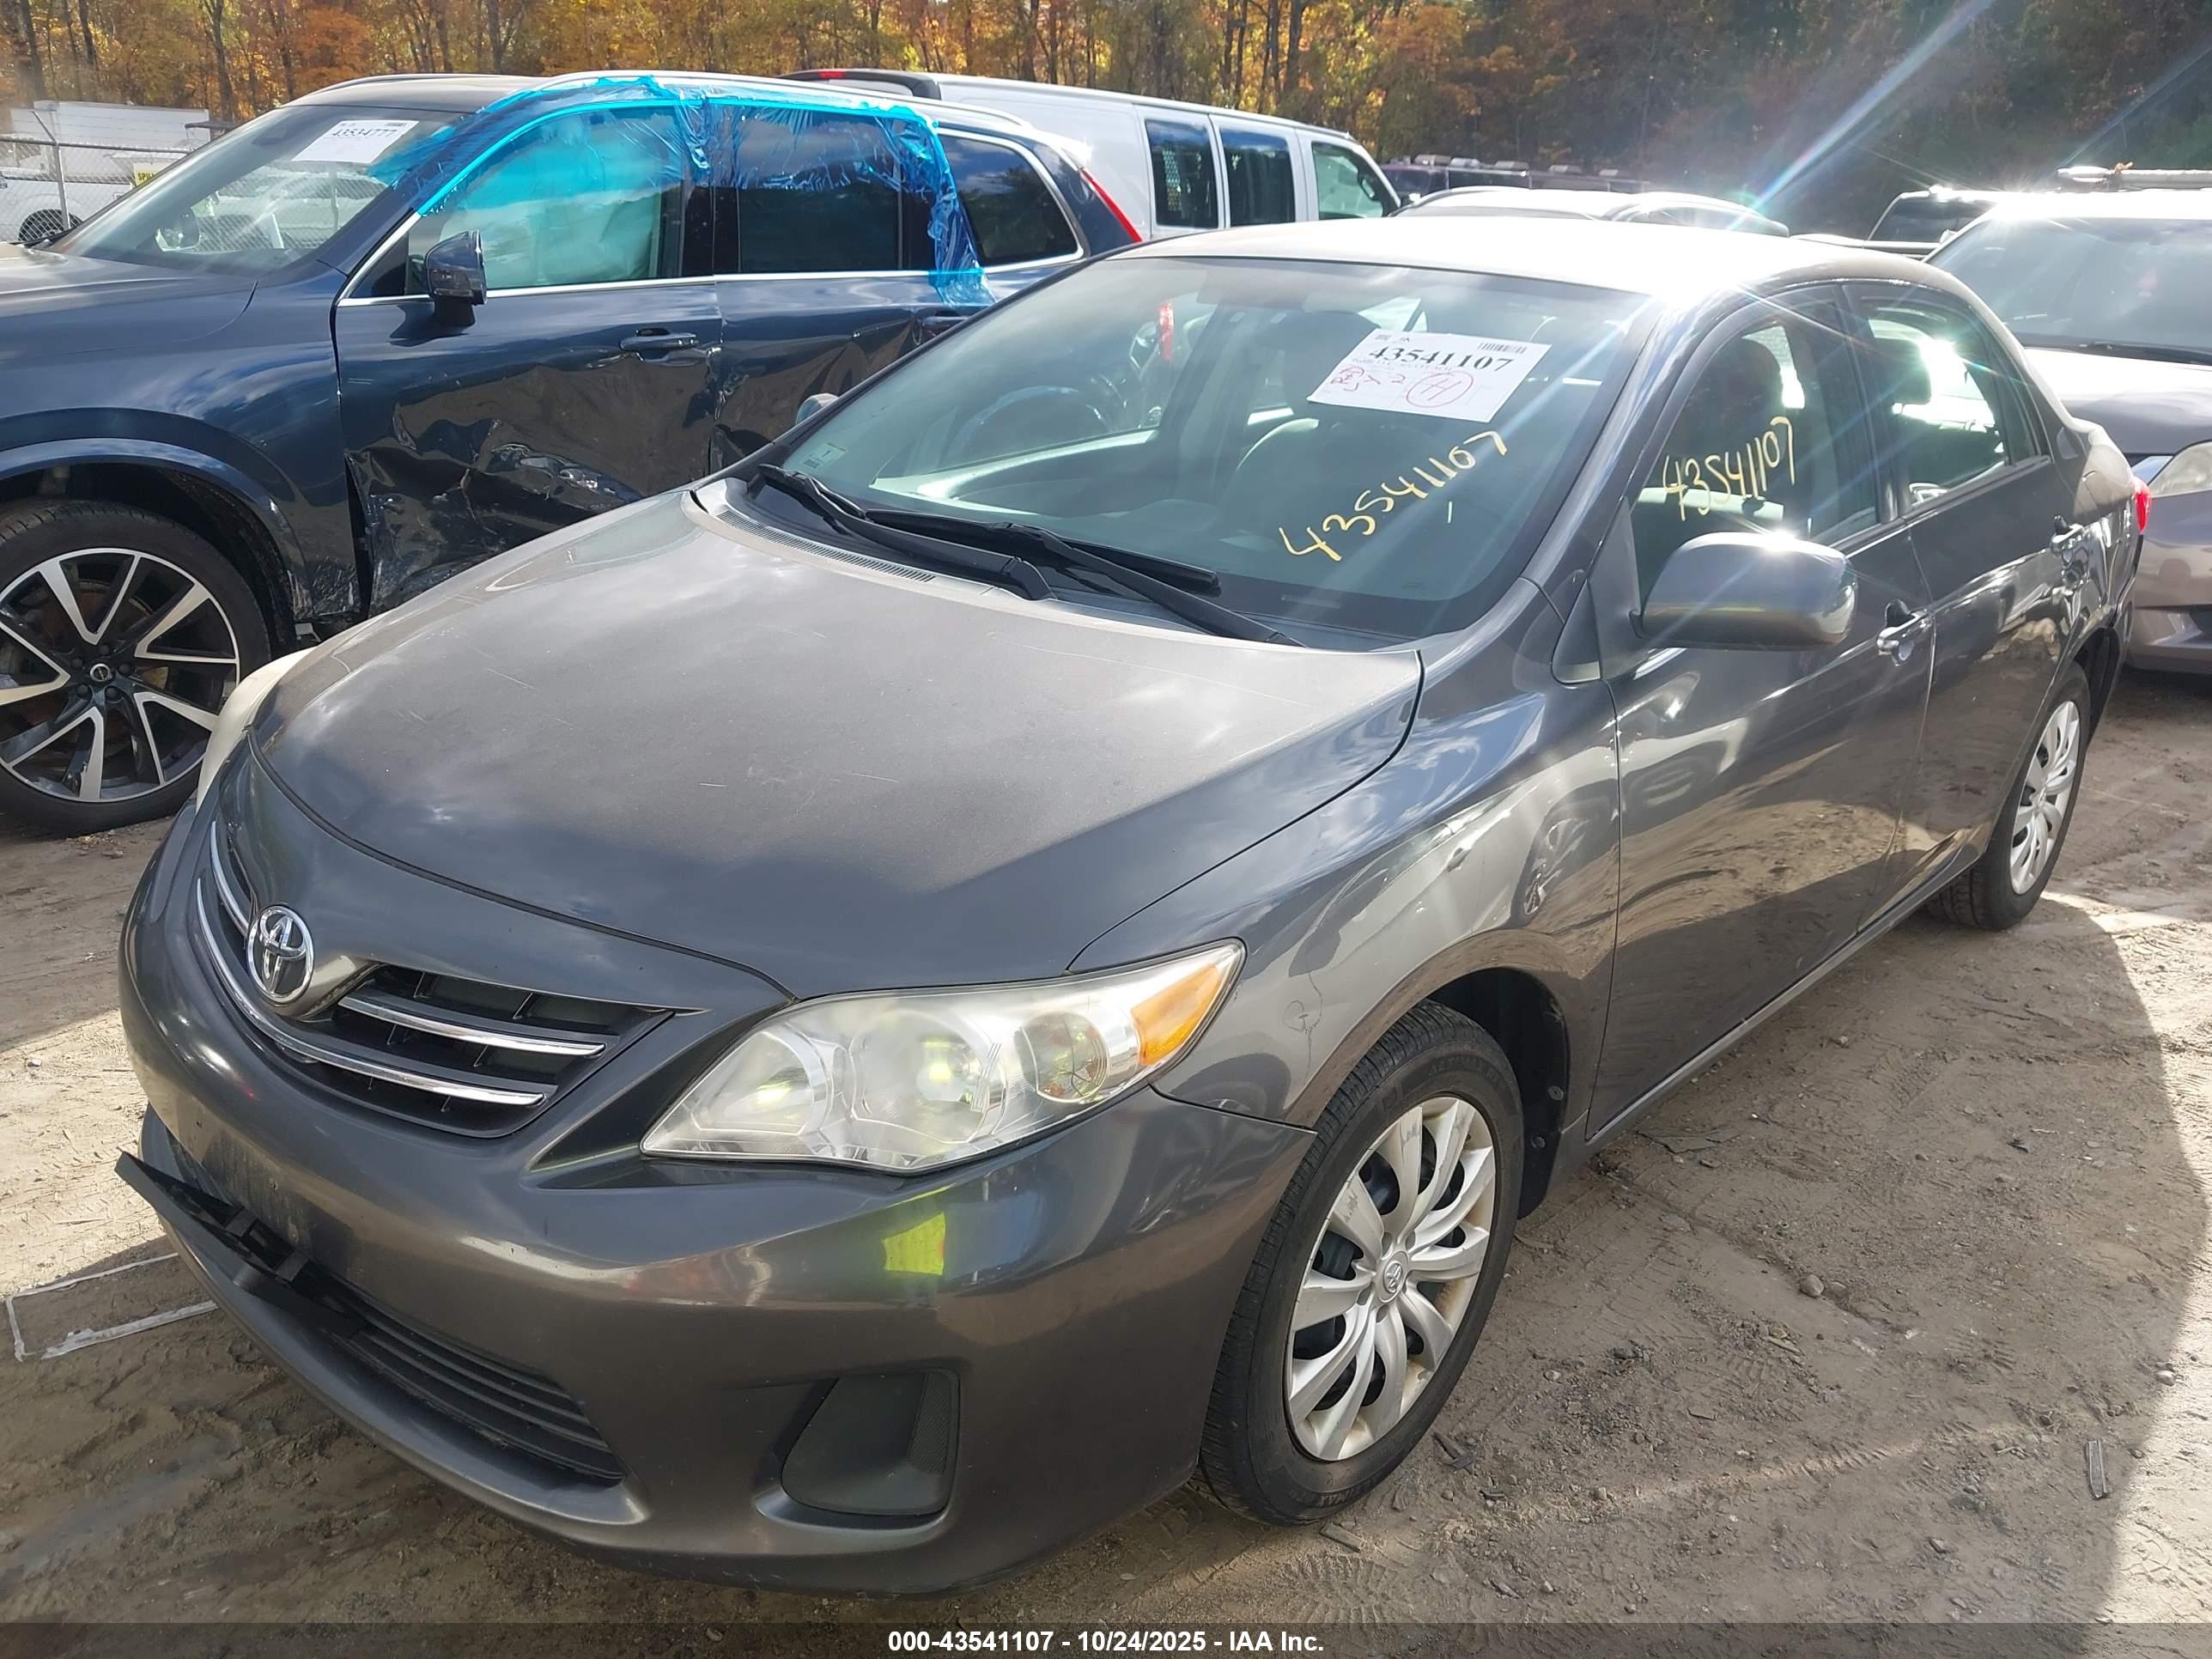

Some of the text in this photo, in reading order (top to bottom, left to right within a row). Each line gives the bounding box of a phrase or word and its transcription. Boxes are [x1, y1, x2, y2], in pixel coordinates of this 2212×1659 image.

[1369, 345, 1515, 372] 43541107
[1279, 430, 1508, 562] 43541107
[1662, 416, 1796, 522] 43541107
